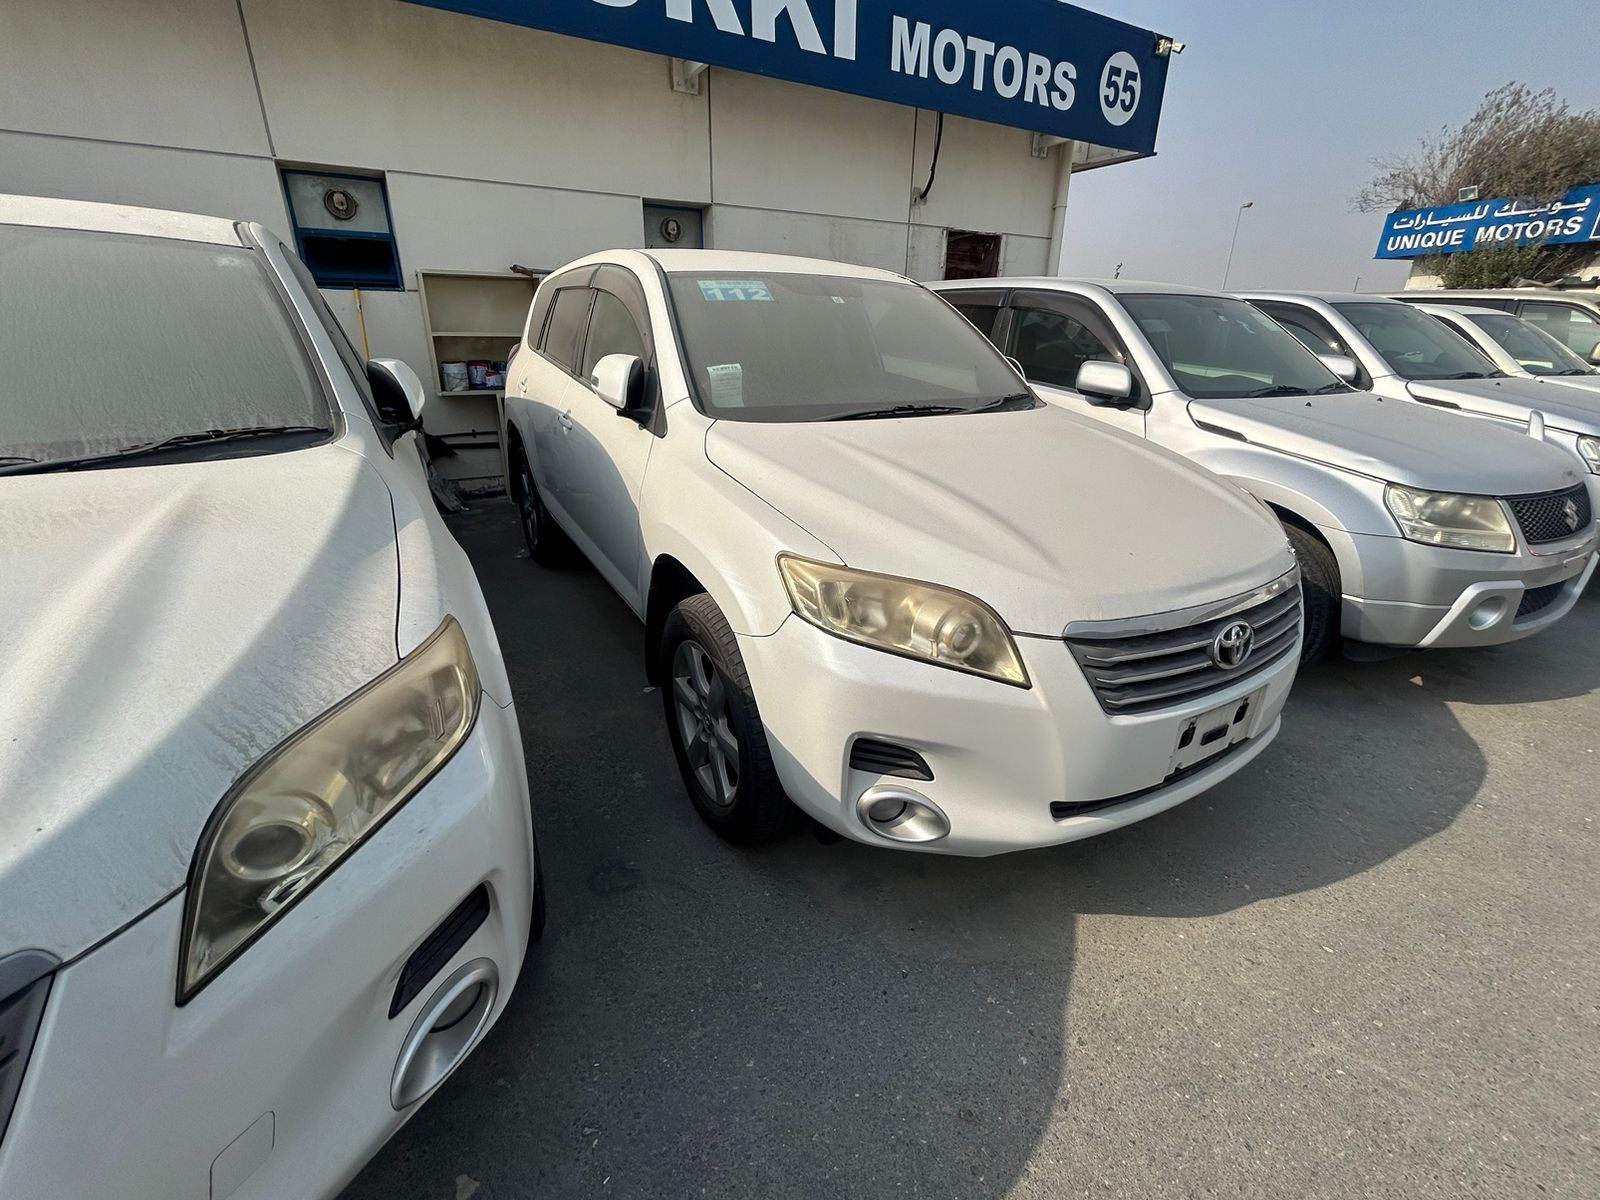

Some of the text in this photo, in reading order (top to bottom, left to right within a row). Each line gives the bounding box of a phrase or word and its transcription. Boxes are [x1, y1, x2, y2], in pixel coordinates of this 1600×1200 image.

[891, 15, 1076, 112] MOTORS
[1103, 66, 1140, 113] 55
[1393, 205, 1489, 230] للسيارات
[1387, 216, 1584, 251] UNIQUE MOTORS
[707, 288, 770, 300] 112
